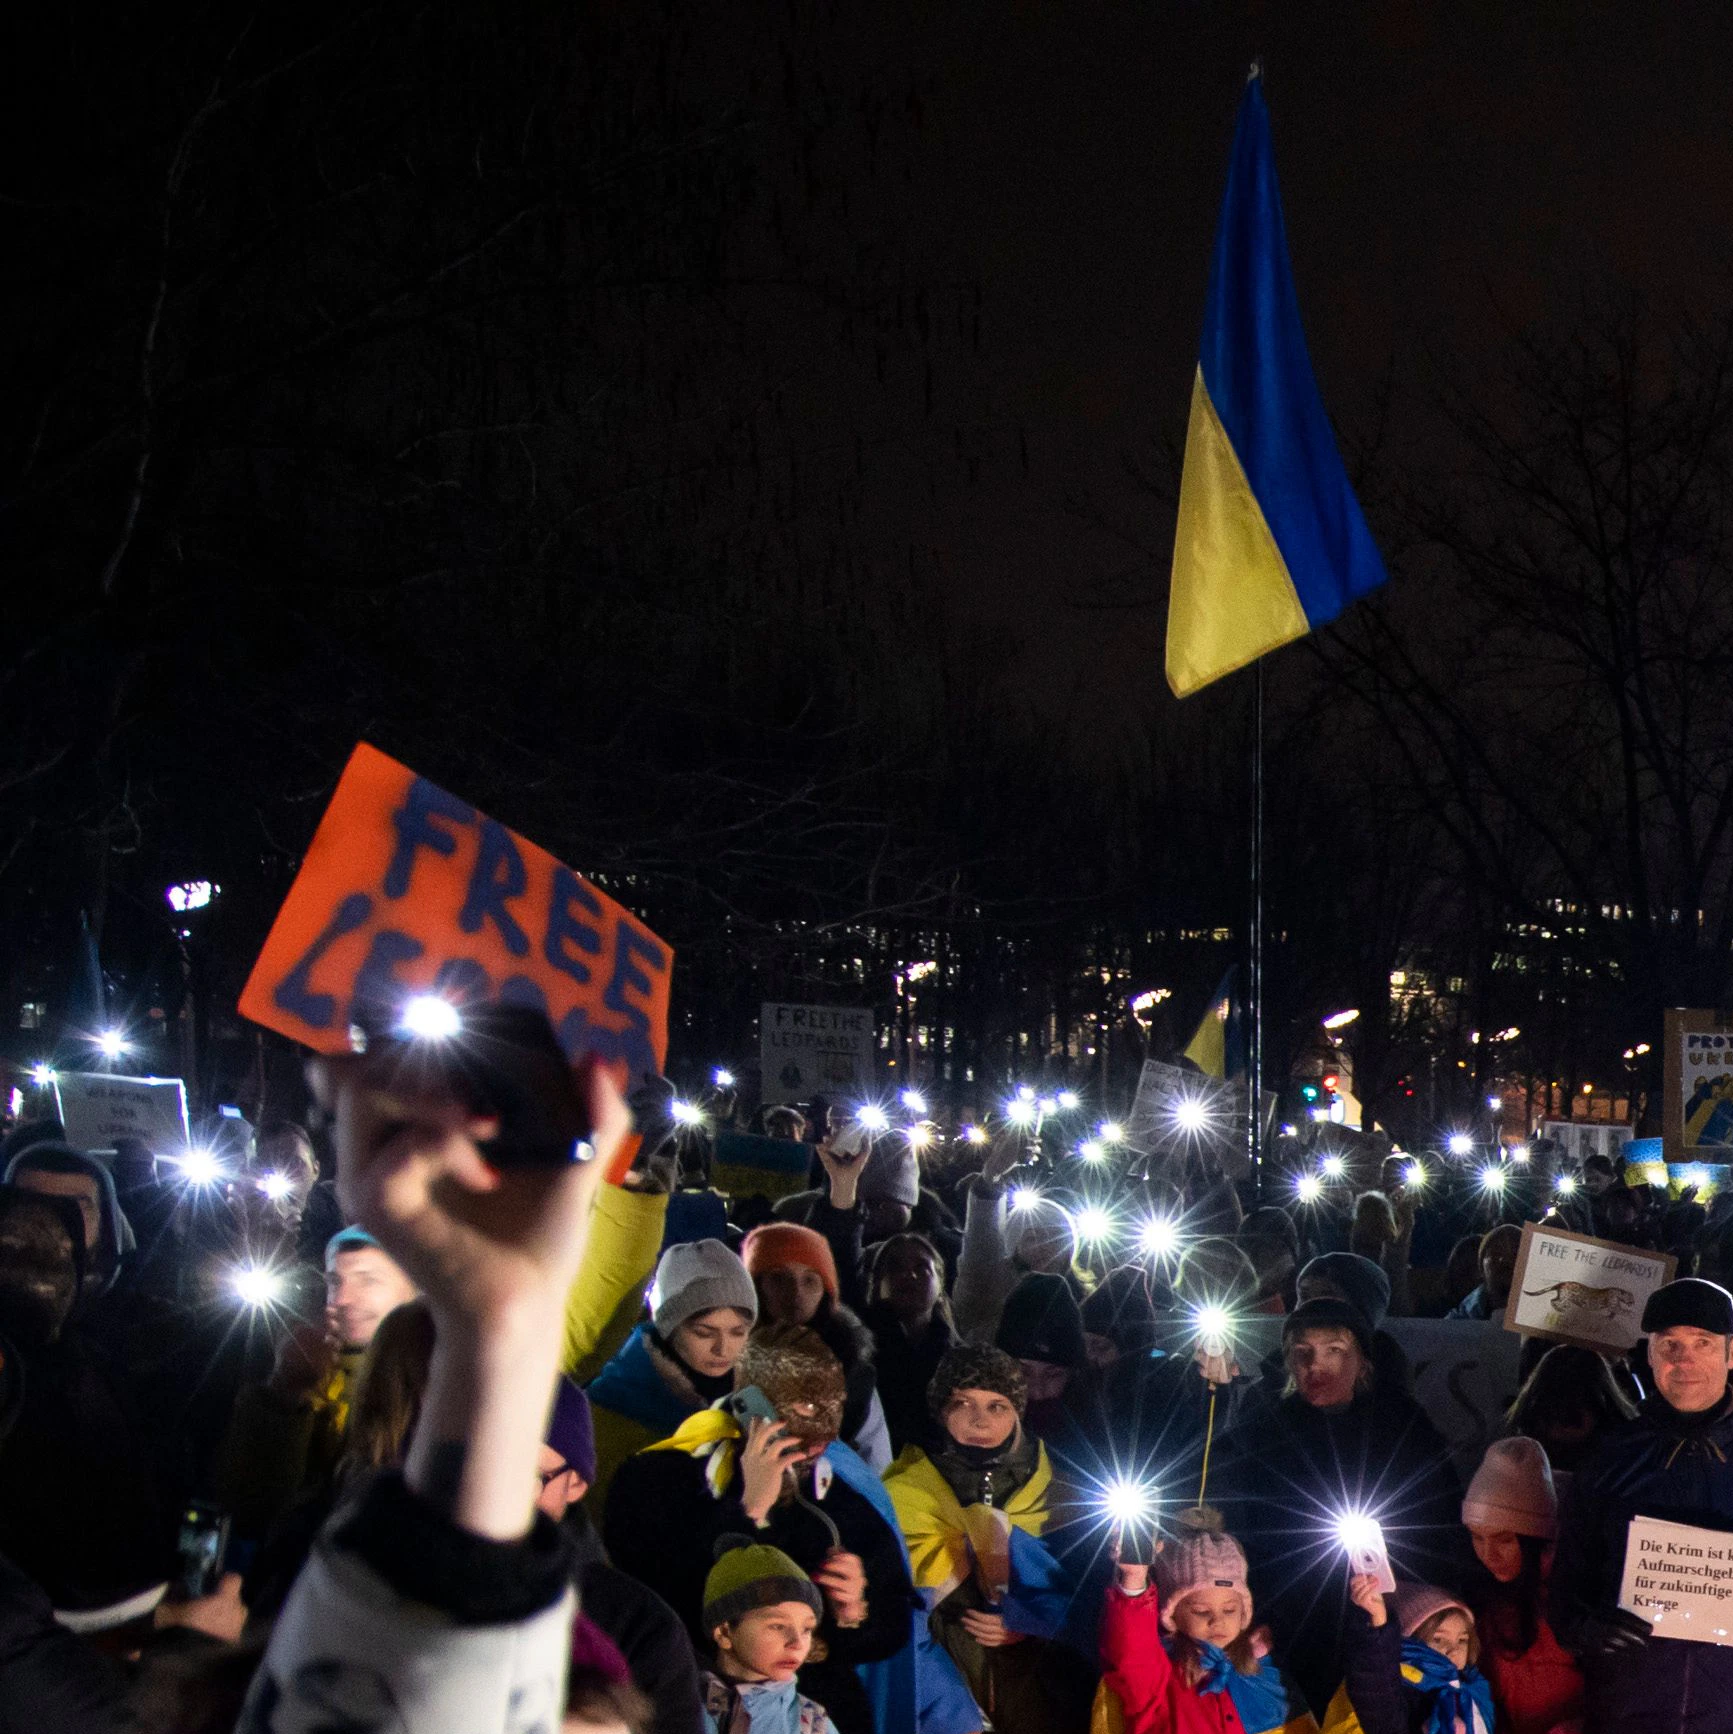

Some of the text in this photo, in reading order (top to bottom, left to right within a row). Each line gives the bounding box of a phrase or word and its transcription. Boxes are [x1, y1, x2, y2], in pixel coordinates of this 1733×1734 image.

[384, 774, 666, 1028] FREE
[776, 1006, 865, 1031] FREE THE
[1539, 1240, 1569, 1260] FREE
[1574, 1249, 1598, 1266] THE
[1640, 1539, 1663, 1553] Die
[1667, 1542, 1703, 1558] Krim
[1708, 1546, 1724, 1560] ist
[1635, 1575, 1733, 1600] für zukünftige
[1633, 1593, 1679, 1613] Kriege
